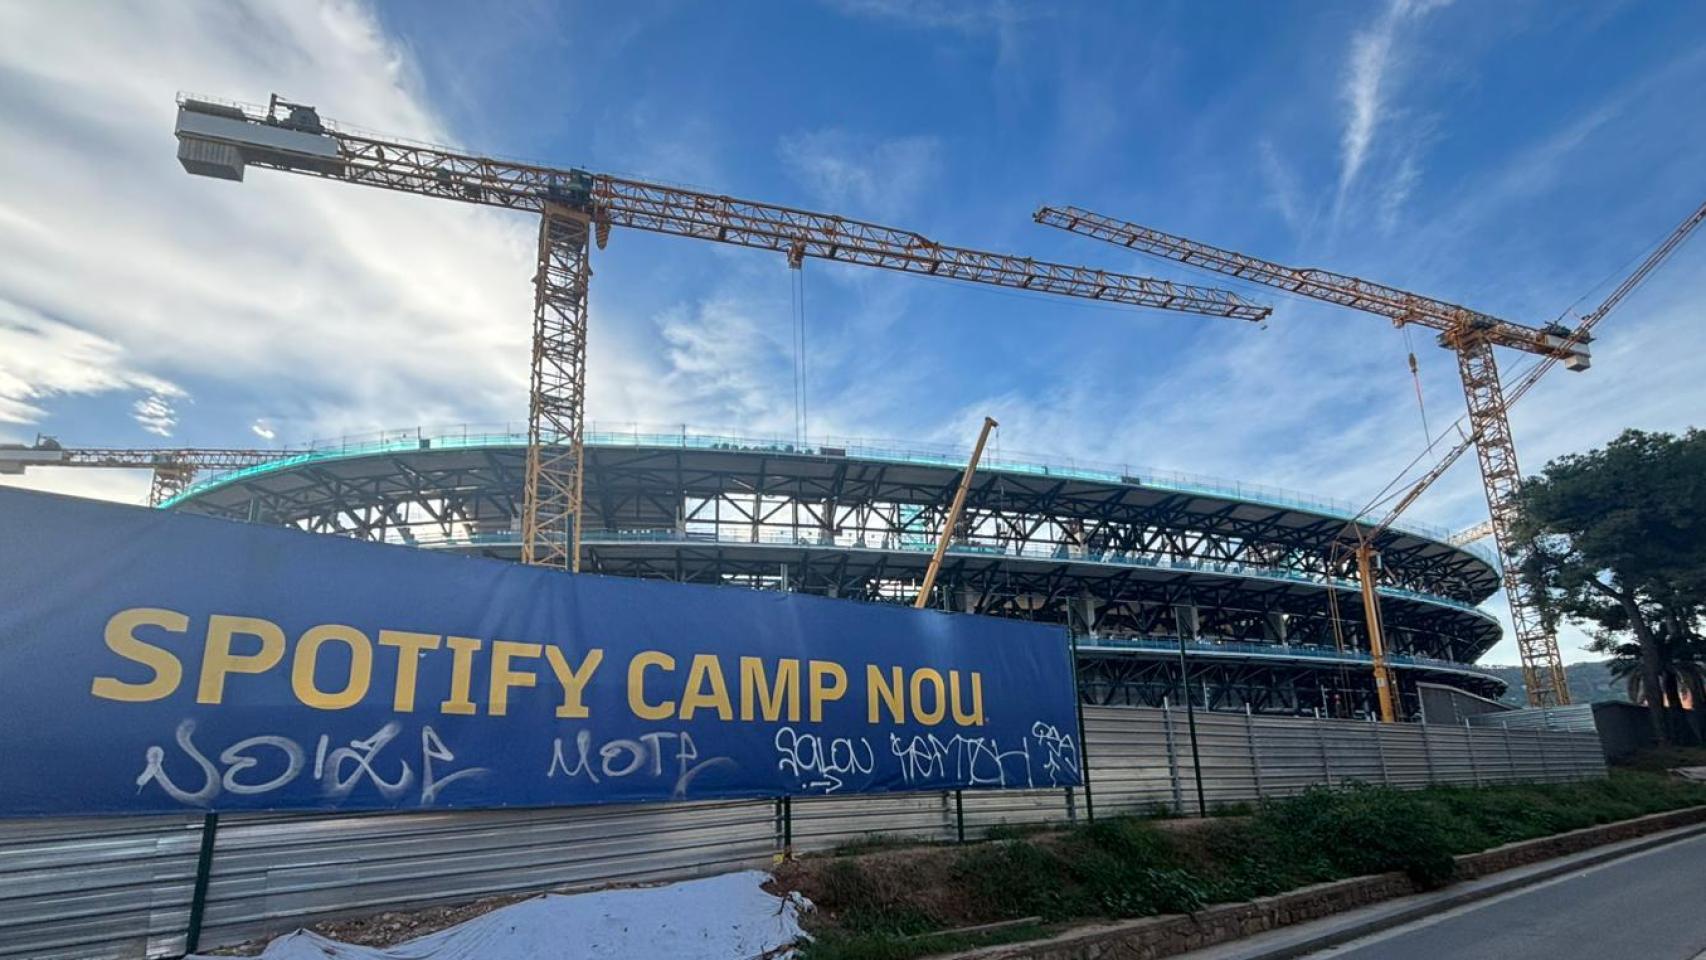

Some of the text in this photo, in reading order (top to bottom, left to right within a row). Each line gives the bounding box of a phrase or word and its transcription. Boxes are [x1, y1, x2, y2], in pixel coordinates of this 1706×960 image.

[91, 608, 983, 726] SPOTIFY CAMP NOU
